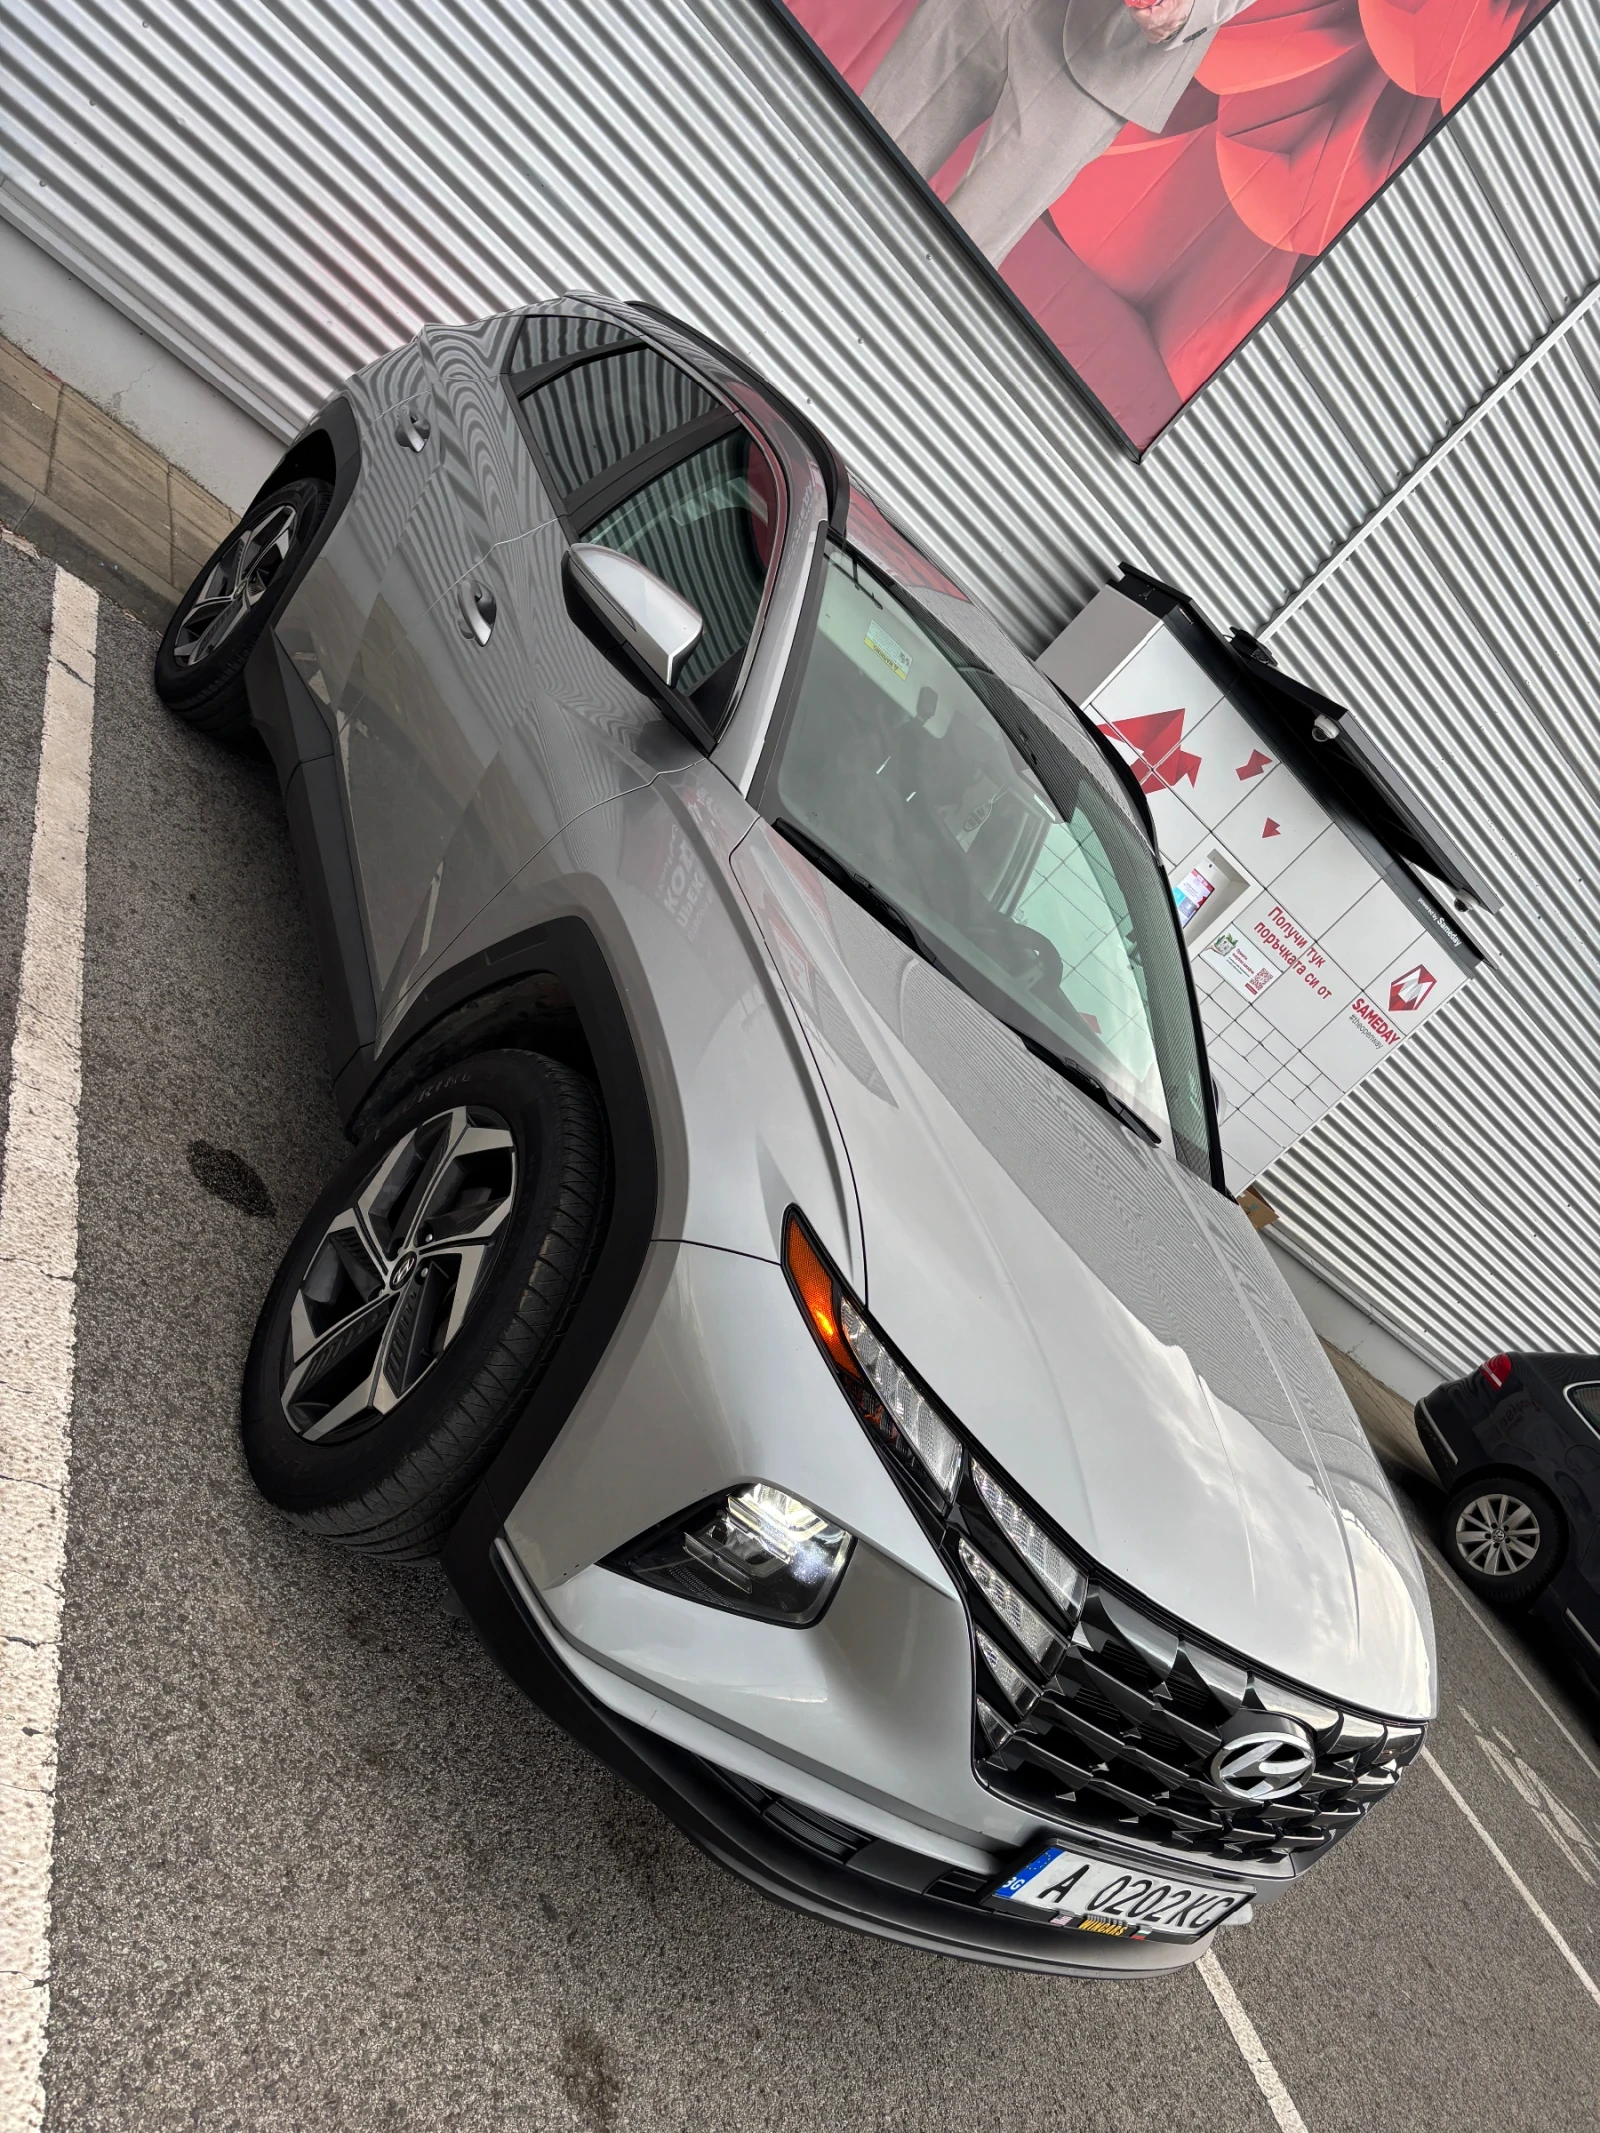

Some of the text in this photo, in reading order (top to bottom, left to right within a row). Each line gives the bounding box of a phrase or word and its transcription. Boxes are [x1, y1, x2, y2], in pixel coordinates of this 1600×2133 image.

[1267, 906, 1326, 968] Получи тук
[1417, 897, 1434, 917] powered
[1437, 917, 1462, 947] Sameday
[1253, 921, 1307, 976] поръчката
[1304, 972, 1320, 989] си
[1317, 985, 1333, 1000] от
[1348, 1014, 1383, 1050] #theopenway
[1351, 997, 1401, 1045] SAMEDAY
[1037, 1864, 1236, 1930] A 0202KC
[1078, 1918, 1127, 1937] WINCARS
